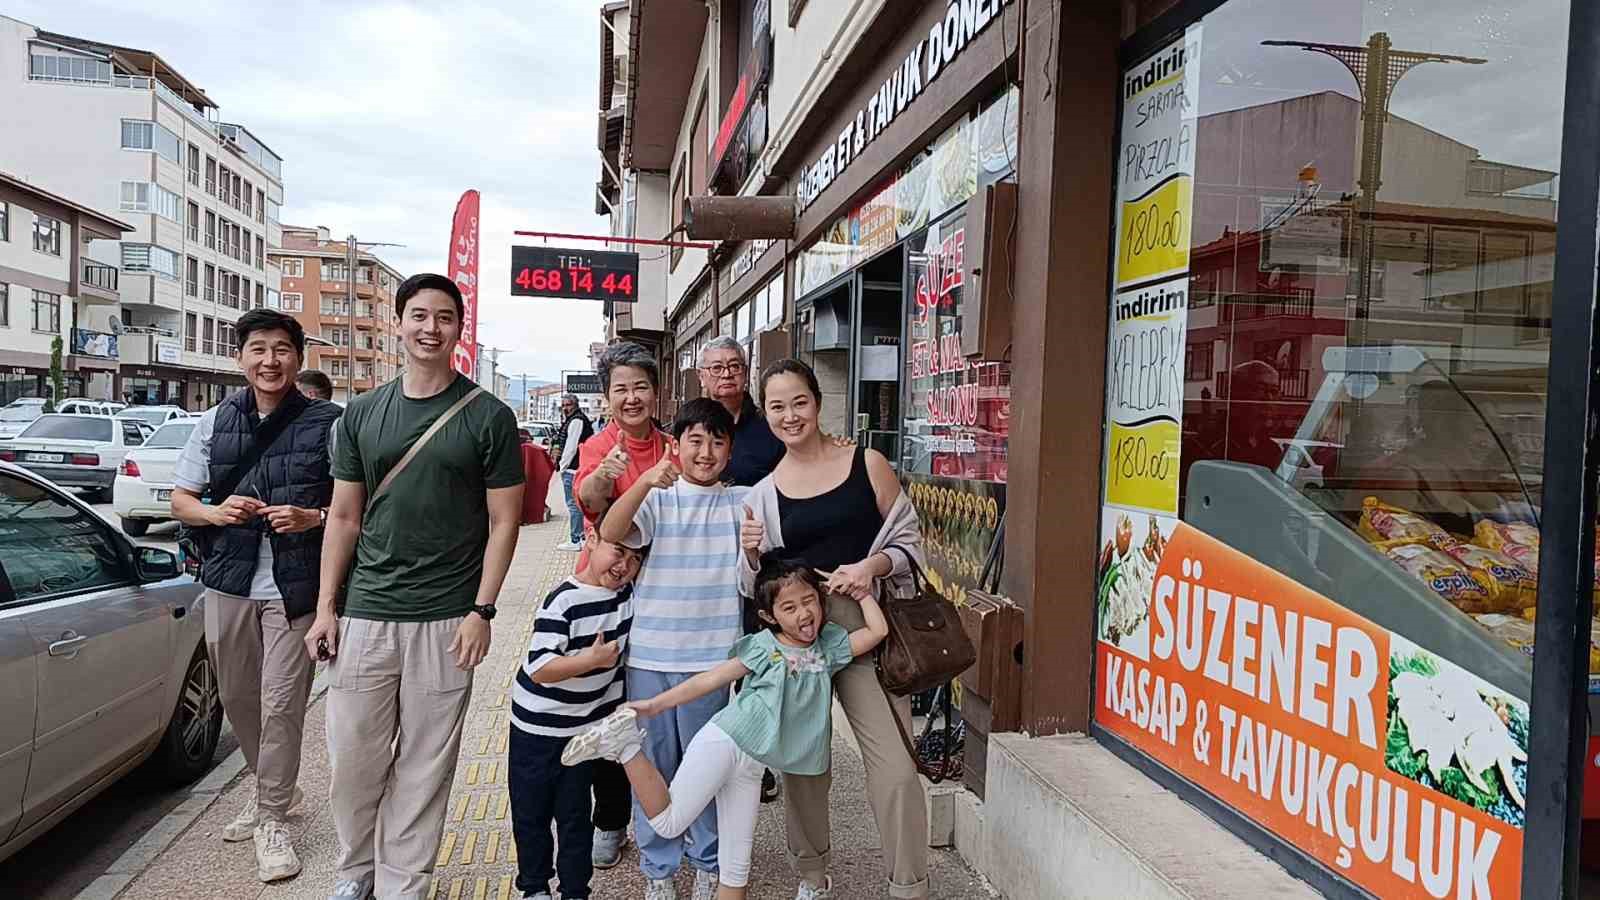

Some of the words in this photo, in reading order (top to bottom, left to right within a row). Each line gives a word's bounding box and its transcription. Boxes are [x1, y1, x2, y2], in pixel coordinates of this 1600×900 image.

[838, 121, 855, 176] ET
[854, 110, 866, 155] &
[868, 39, 924, 141] TAVUK
[926, 0, 1009, 82] DÖNE
[1135, 82, 1191, 128] SARMA
[515, 267, 563, 292] 468
[569, 269, 594, 293] 14
[601, 272, 634, 296] 44
[1116, 288, 1185, 321] indirim
[912, 341, 929, 380] ET
[927, 382, 979, 426] SALONU
[1153, 558, 1379, 751] SÜZENER
[1105, 652, 1188, 747] KASAP
[1192, 699, 1211, 767] &
[1219, 703, 1502, 900] TAVUKÇULUK
